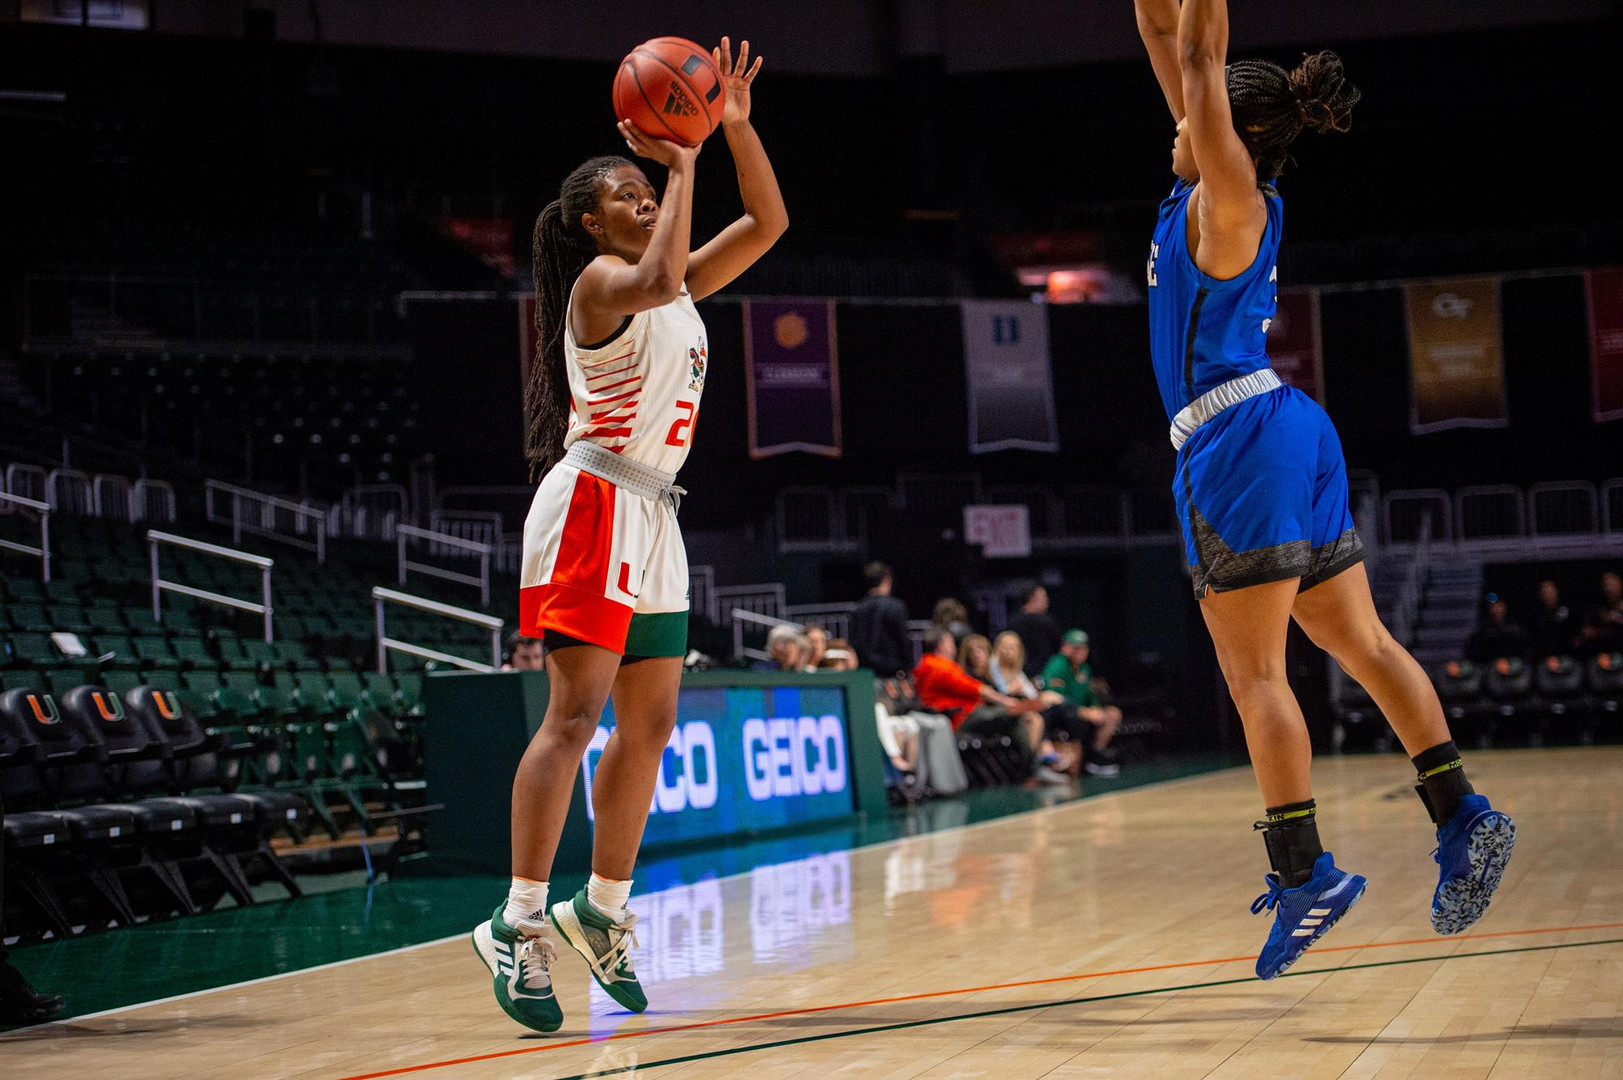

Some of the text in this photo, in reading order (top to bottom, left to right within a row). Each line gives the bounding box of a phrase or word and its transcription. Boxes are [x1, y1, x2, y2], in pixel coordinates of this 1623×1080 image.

[669, 81, 699, 116] adidas
[26, 694, 60, 724] U
[92, 691, 125, 721] U
[151, 691, 182, 720] U
[743, 715, 846, 800] GEICO
